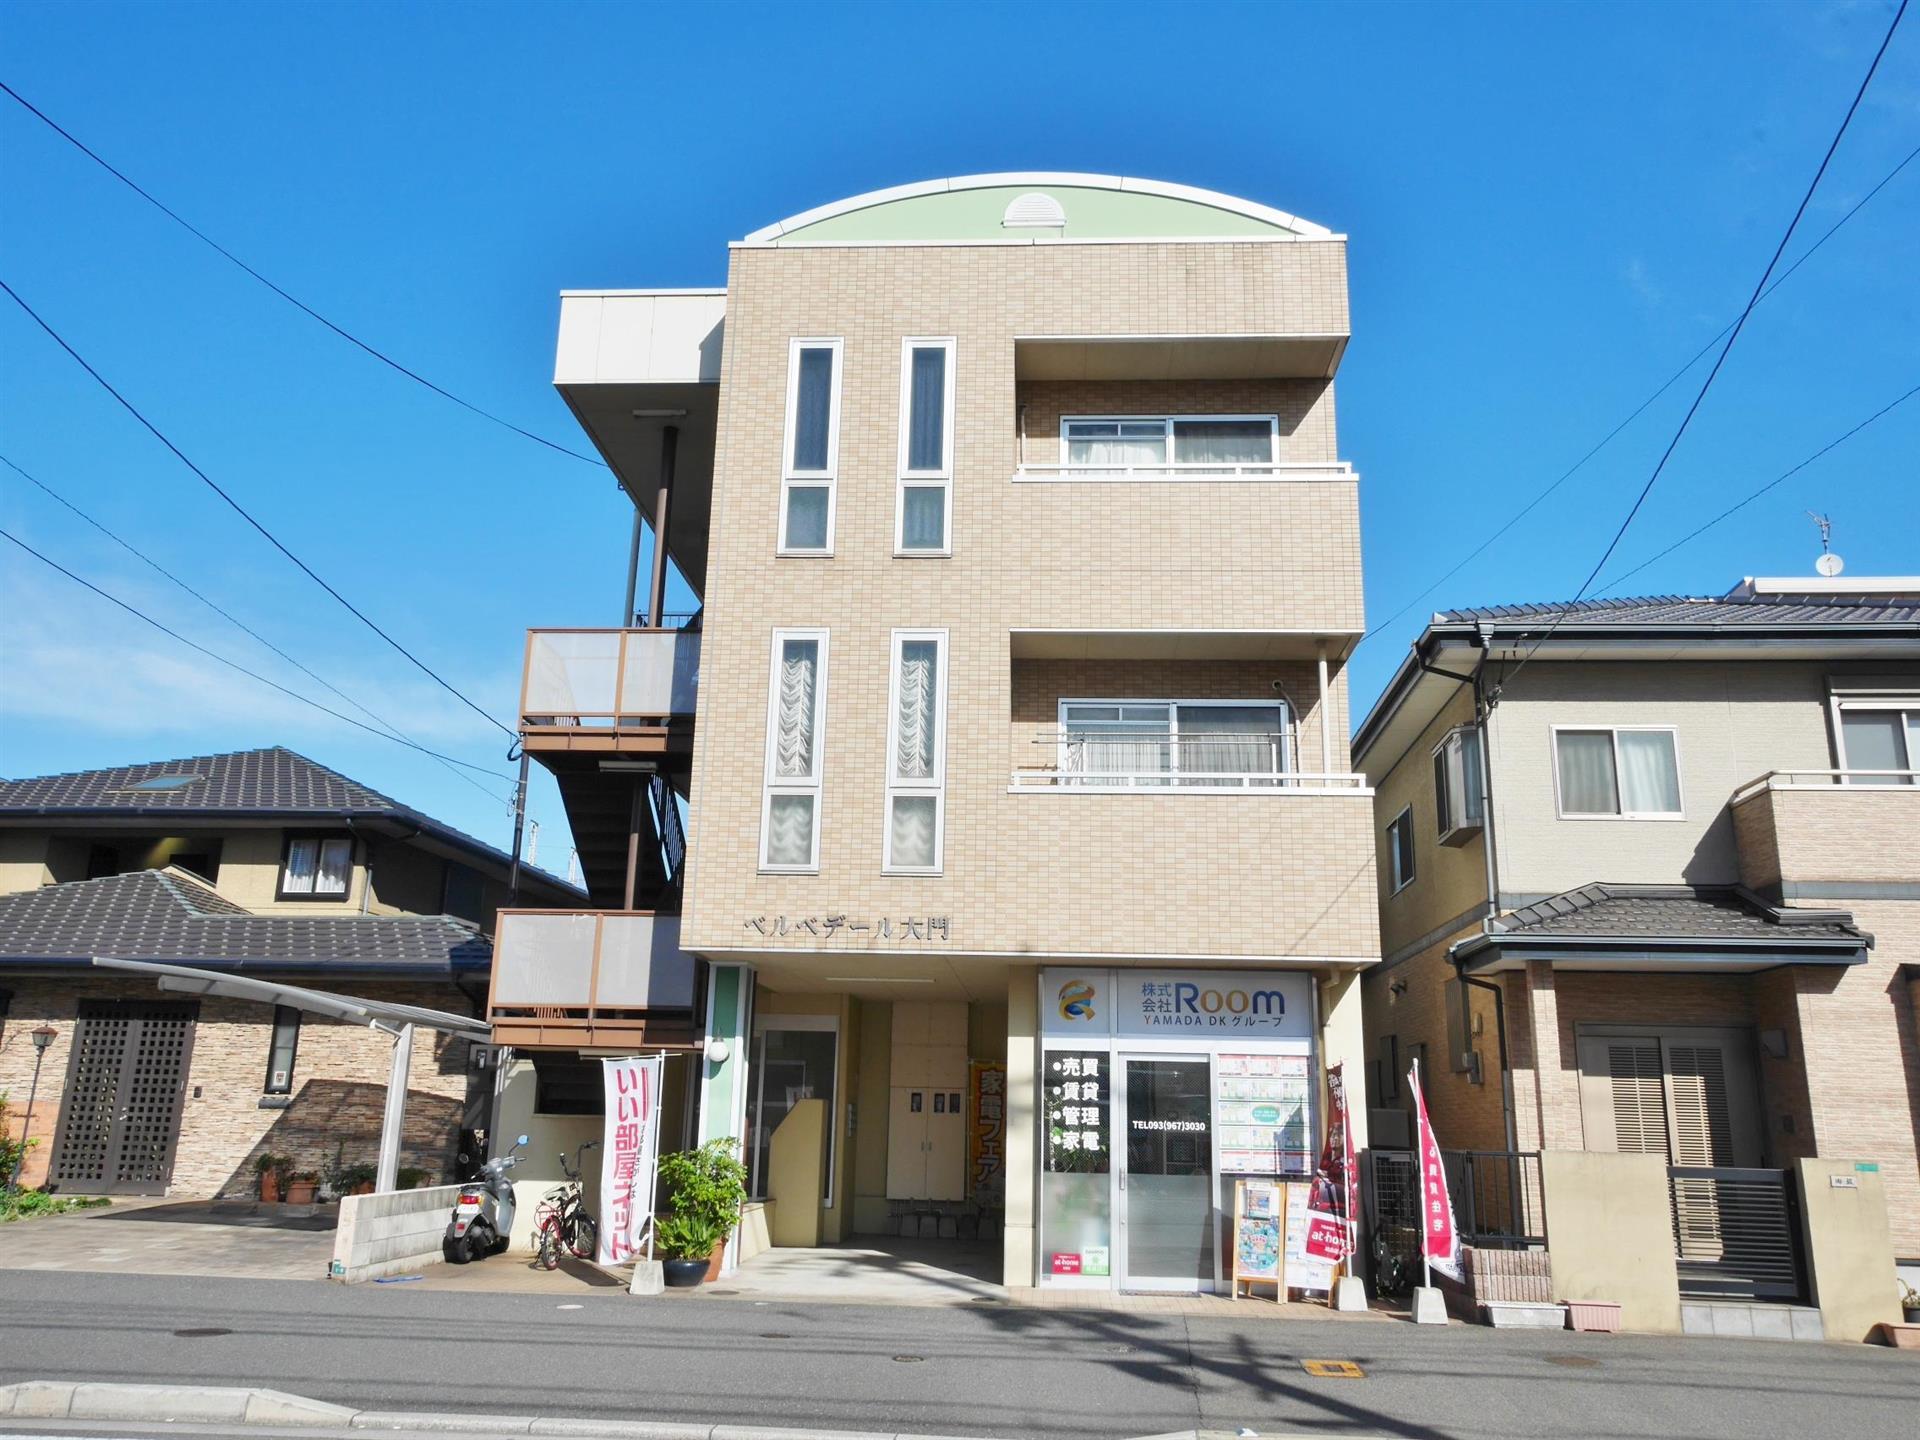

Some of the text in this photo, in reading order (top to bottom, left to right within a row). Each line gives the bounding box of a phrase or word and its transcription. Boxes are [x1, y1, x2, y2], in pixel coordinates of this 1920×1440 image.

[744, 915, 949, 941] ベルベデール大門
[1141, 982, 1172, 997] 株式
[1175, 982, 1285, 1014] Room
[1142, 998, 1172, 1013] 会社
[1144, 1015, 1202, 1026] YAMADA
[1209, 1016, 1227, 1026] DK
[1062, 1057, 1099, 1077] 売買
[1062, 1081, 1100, 1101] 賃貸
[1062, 1106, 1100, 1126] 管理
[1062, 1130, 1100, 1151] 家電
